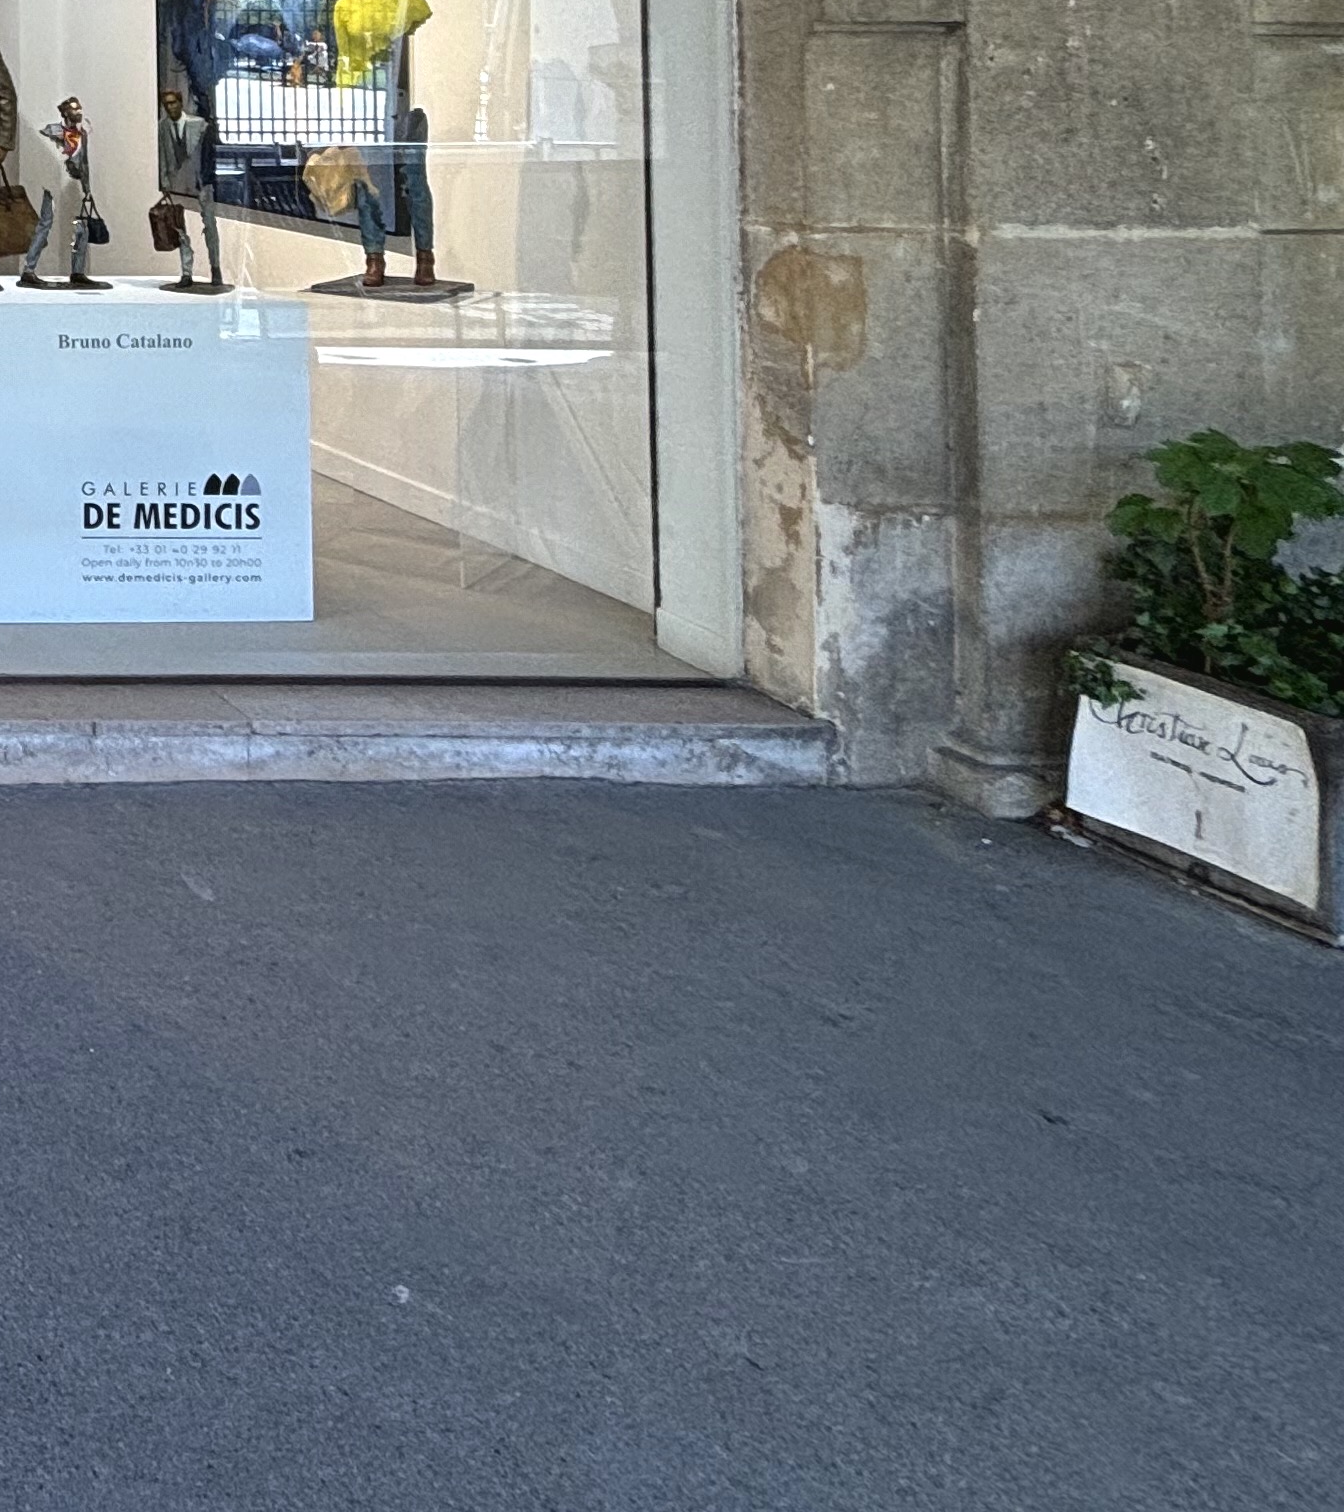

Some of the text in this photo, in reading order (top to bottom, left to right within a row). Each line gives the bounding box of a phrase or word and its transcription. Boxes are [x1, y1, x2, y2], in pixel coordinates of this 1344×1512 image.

[58, 333, 193, 349] Bruno Catalano
[81, 481, 197, 496] GALERIE
[84, 503, 261, 530] DE MEDICIS
[81, 557, 112, 569] Open
[116, 557, 142, 569] daily
[145, 557, 172, 568] from
